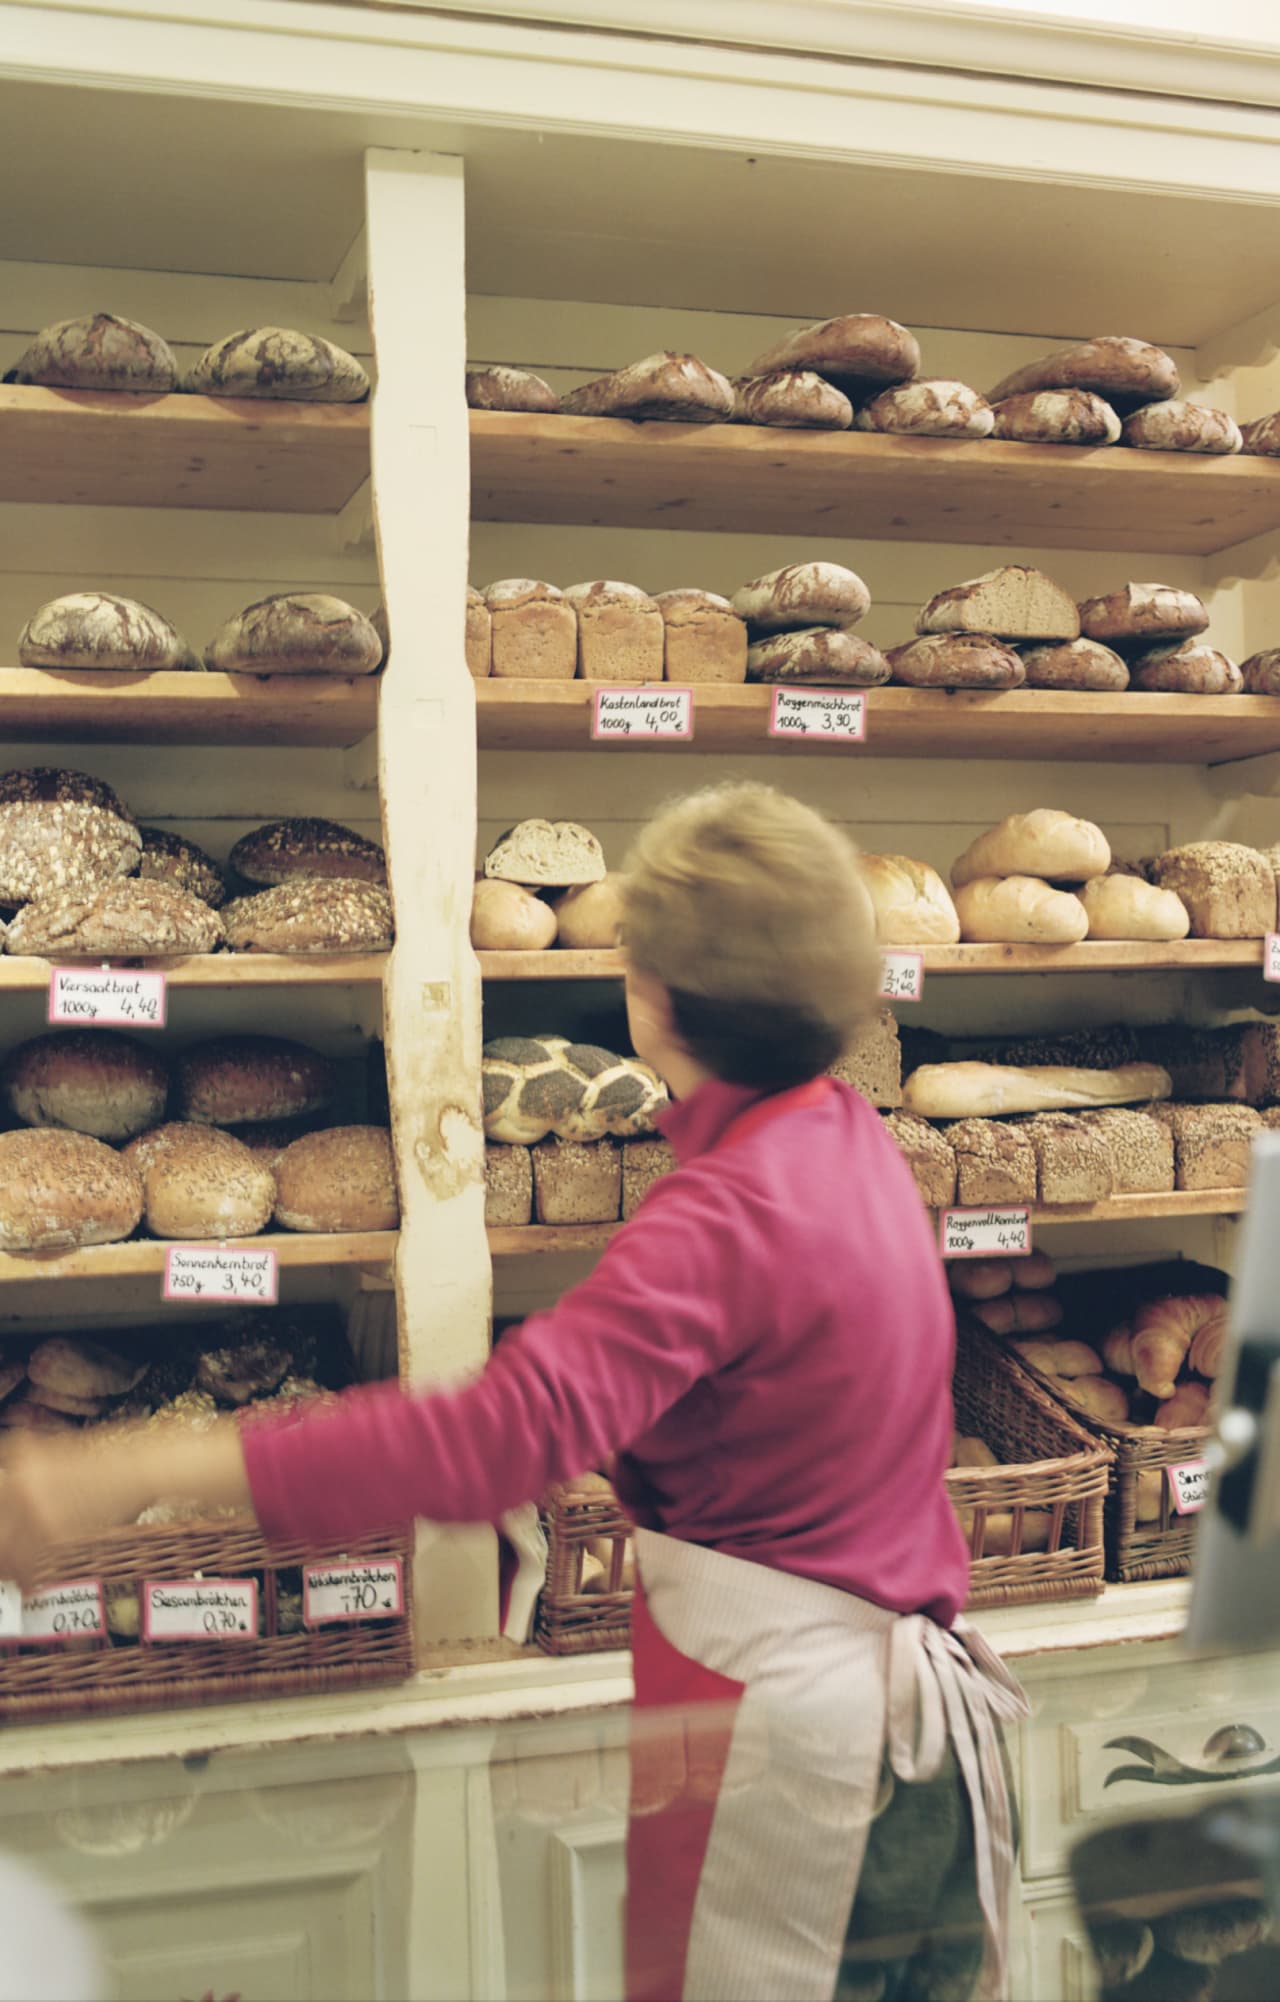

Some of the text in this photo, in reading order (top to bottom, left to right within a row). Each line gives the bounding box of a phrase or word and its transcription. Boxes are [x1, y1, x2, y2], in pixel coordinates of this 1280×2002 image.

[600, 694, 681, 709] Kastenlandbrot
[777, 692, 861, 711] Roggenmischbrot
[600, 717, 632, 734] 1000g
[777, 715, 811, 733] 1000g
[171, 1252, 269, 1271] Sonnenkernbrot
